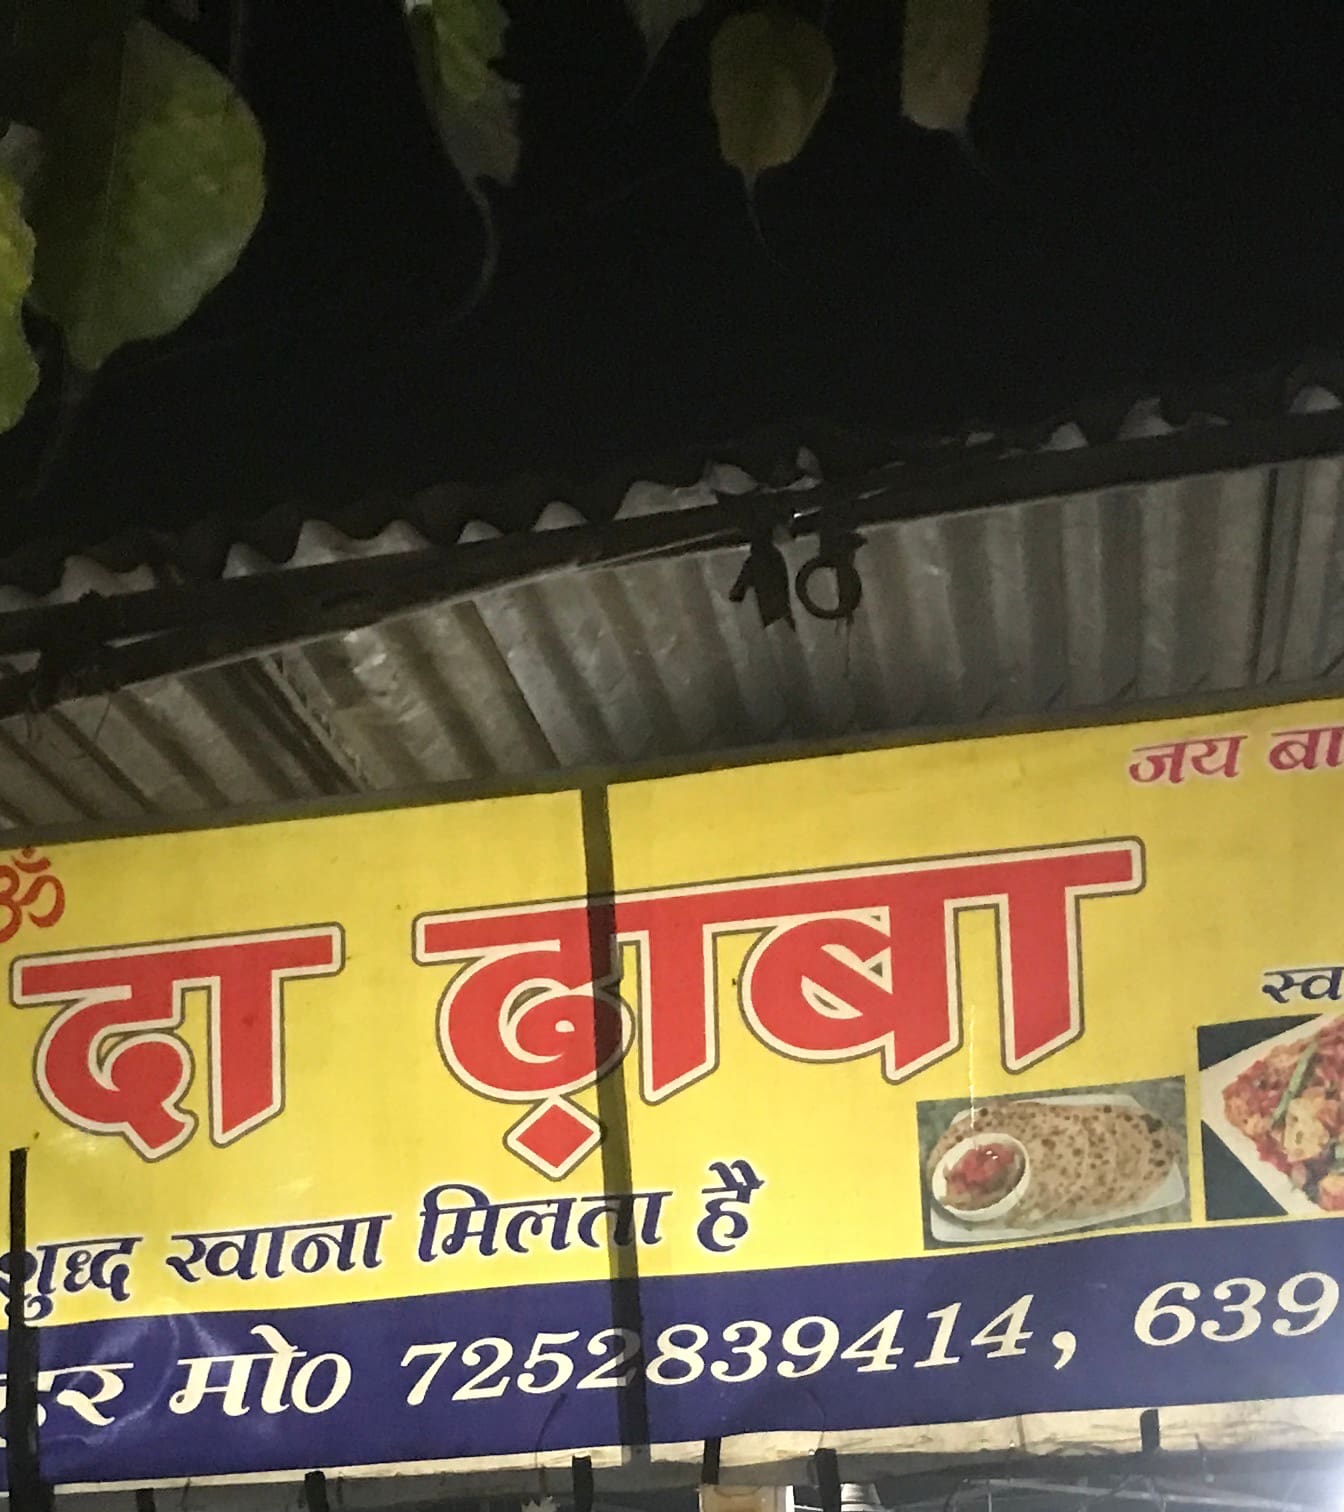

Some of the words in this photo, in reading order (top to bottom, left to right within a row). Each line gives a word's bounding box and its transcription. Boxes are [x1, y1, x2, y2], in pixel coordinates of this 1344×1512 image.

[1128, 735, 1248, 788] जय
[9, 922, 346, 1163] दा
[413, 836, 1146, 1182] ढ़ाबा
[165, 1213, 391, 1284] खाना
[418, 1182, 669, 1263] मिलता
[697, 1158, 764, 1253] है
[399, 1293, 1077, 1407] 7252839414,
